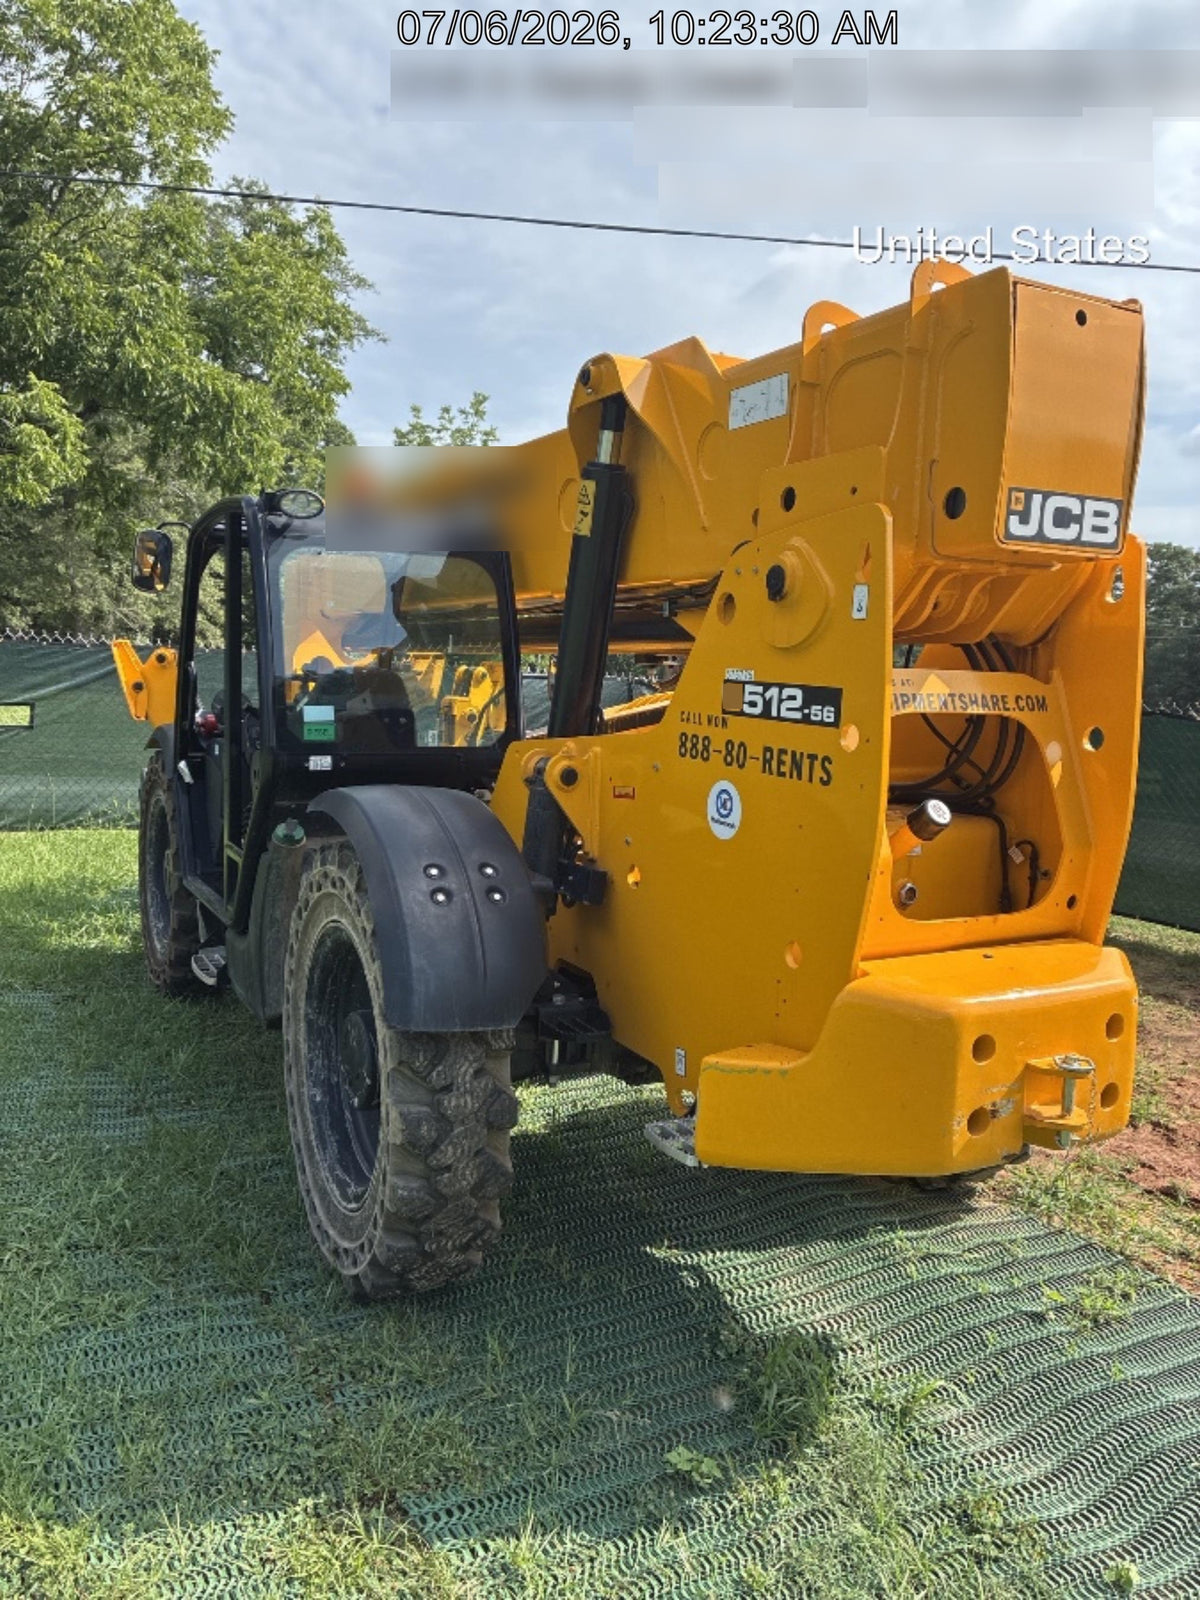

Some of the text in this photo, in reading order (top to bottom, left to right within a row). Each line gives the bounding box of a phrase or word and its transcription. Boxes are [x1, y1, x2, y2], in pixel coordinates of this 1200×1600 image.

[1008, 493, 1120, 543] JCB
[680, 710, 729, 729] CALL NOW
[742, 683, 836, 723] 512-56
[890, 692, 1049, 713] IPMENTSHARE.COM
[678, 731, 834, 787] 888-80-RENTS
